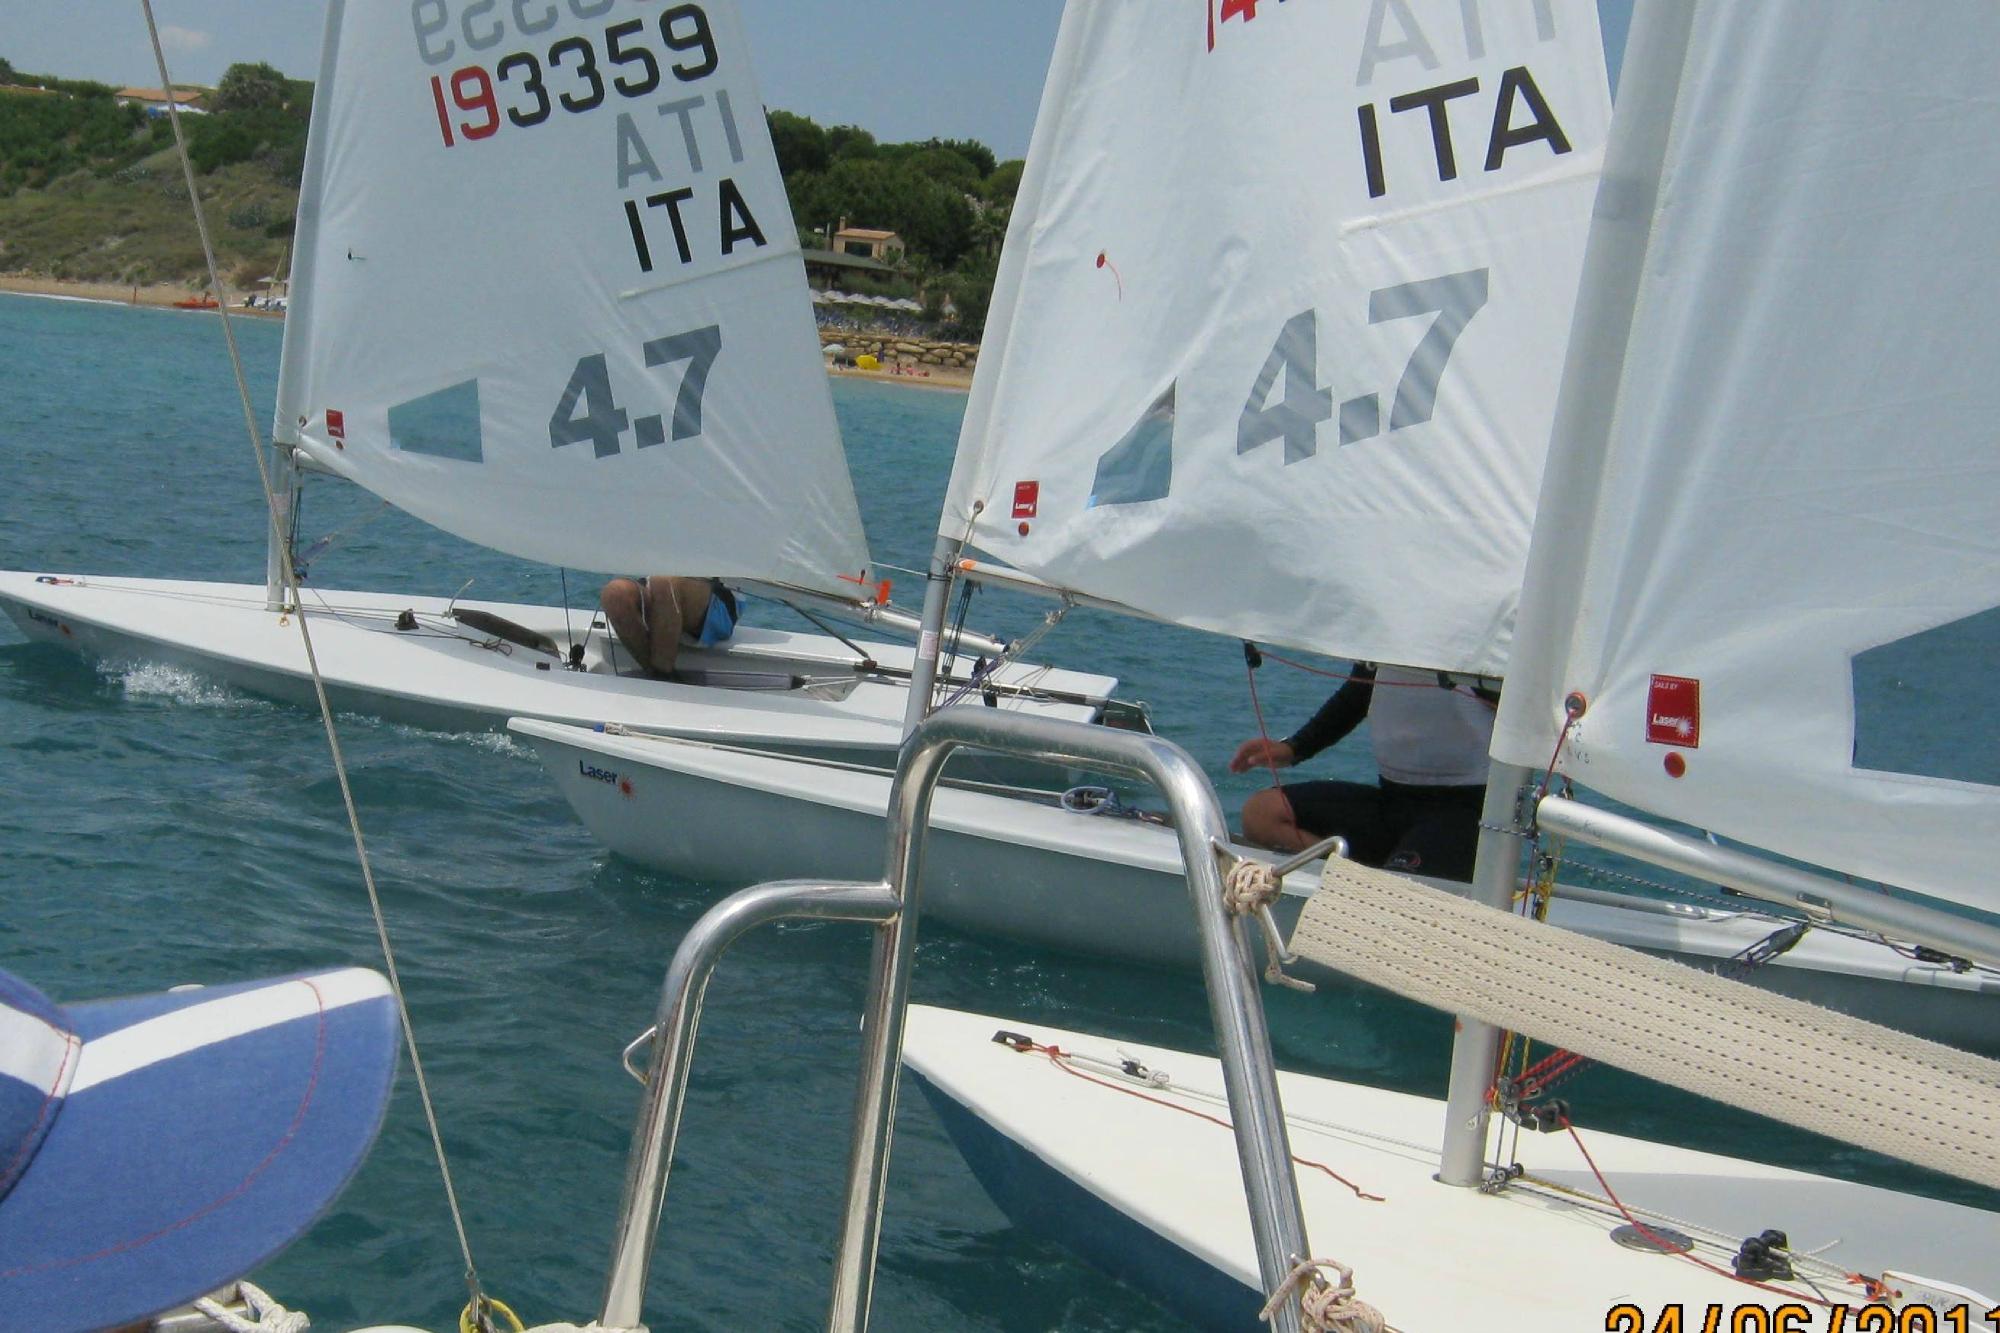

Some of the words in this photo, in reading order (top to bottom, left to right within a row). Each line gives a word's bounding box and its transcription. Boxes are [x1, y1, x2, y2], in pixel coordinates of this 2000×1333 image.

[430, 3, 718, 148] 193359
[1357, 65, 1573, 198] ITA
[624, 177, 767, 273] ITA
[548, 324, 722, 459] 4.7
[1236, 266, 1489, 466] 4.7
[579, 759, 618, 784] Laser
[1652, 713, 1678, 728] Laser
